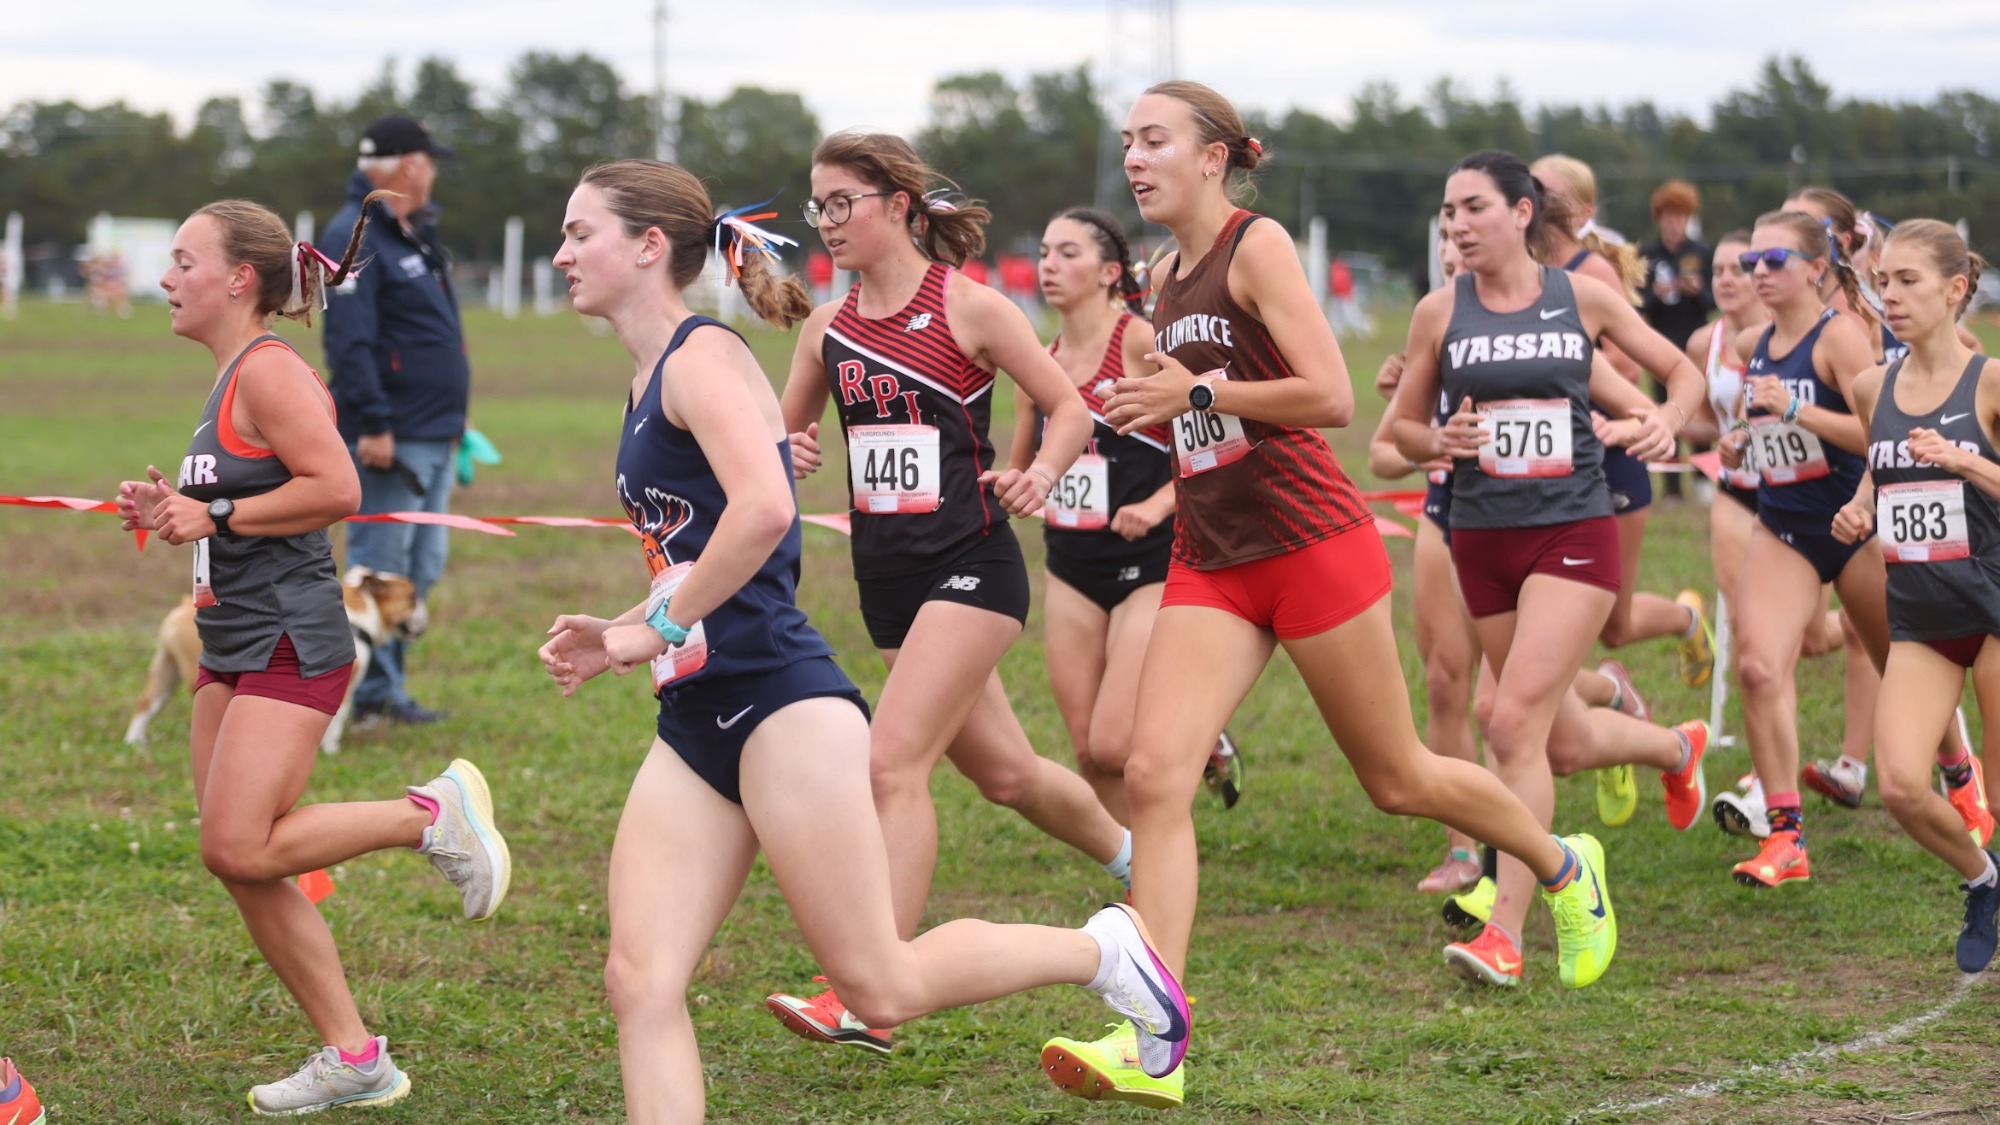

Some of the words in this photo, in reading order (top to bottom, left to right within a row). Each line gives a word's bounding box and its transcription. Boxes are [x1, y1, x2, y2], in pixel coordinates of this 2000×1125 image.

[1166, 313, 1234, 353] LAWRENCE
[1448, 332, 1585, 369] VASSAR
[837, 360, 922, 425] RPI
[1181, 409, 1226, 452] 506
[1495, 420, 1553, 458] 576
[1762, 431, 1808, 468] 519
[178, 454, 218, 489] AR
[864, 447, 919, 491] 446
[1053, 475, 1092, 509] 452
[1892, 502, 1948, 543] 583
